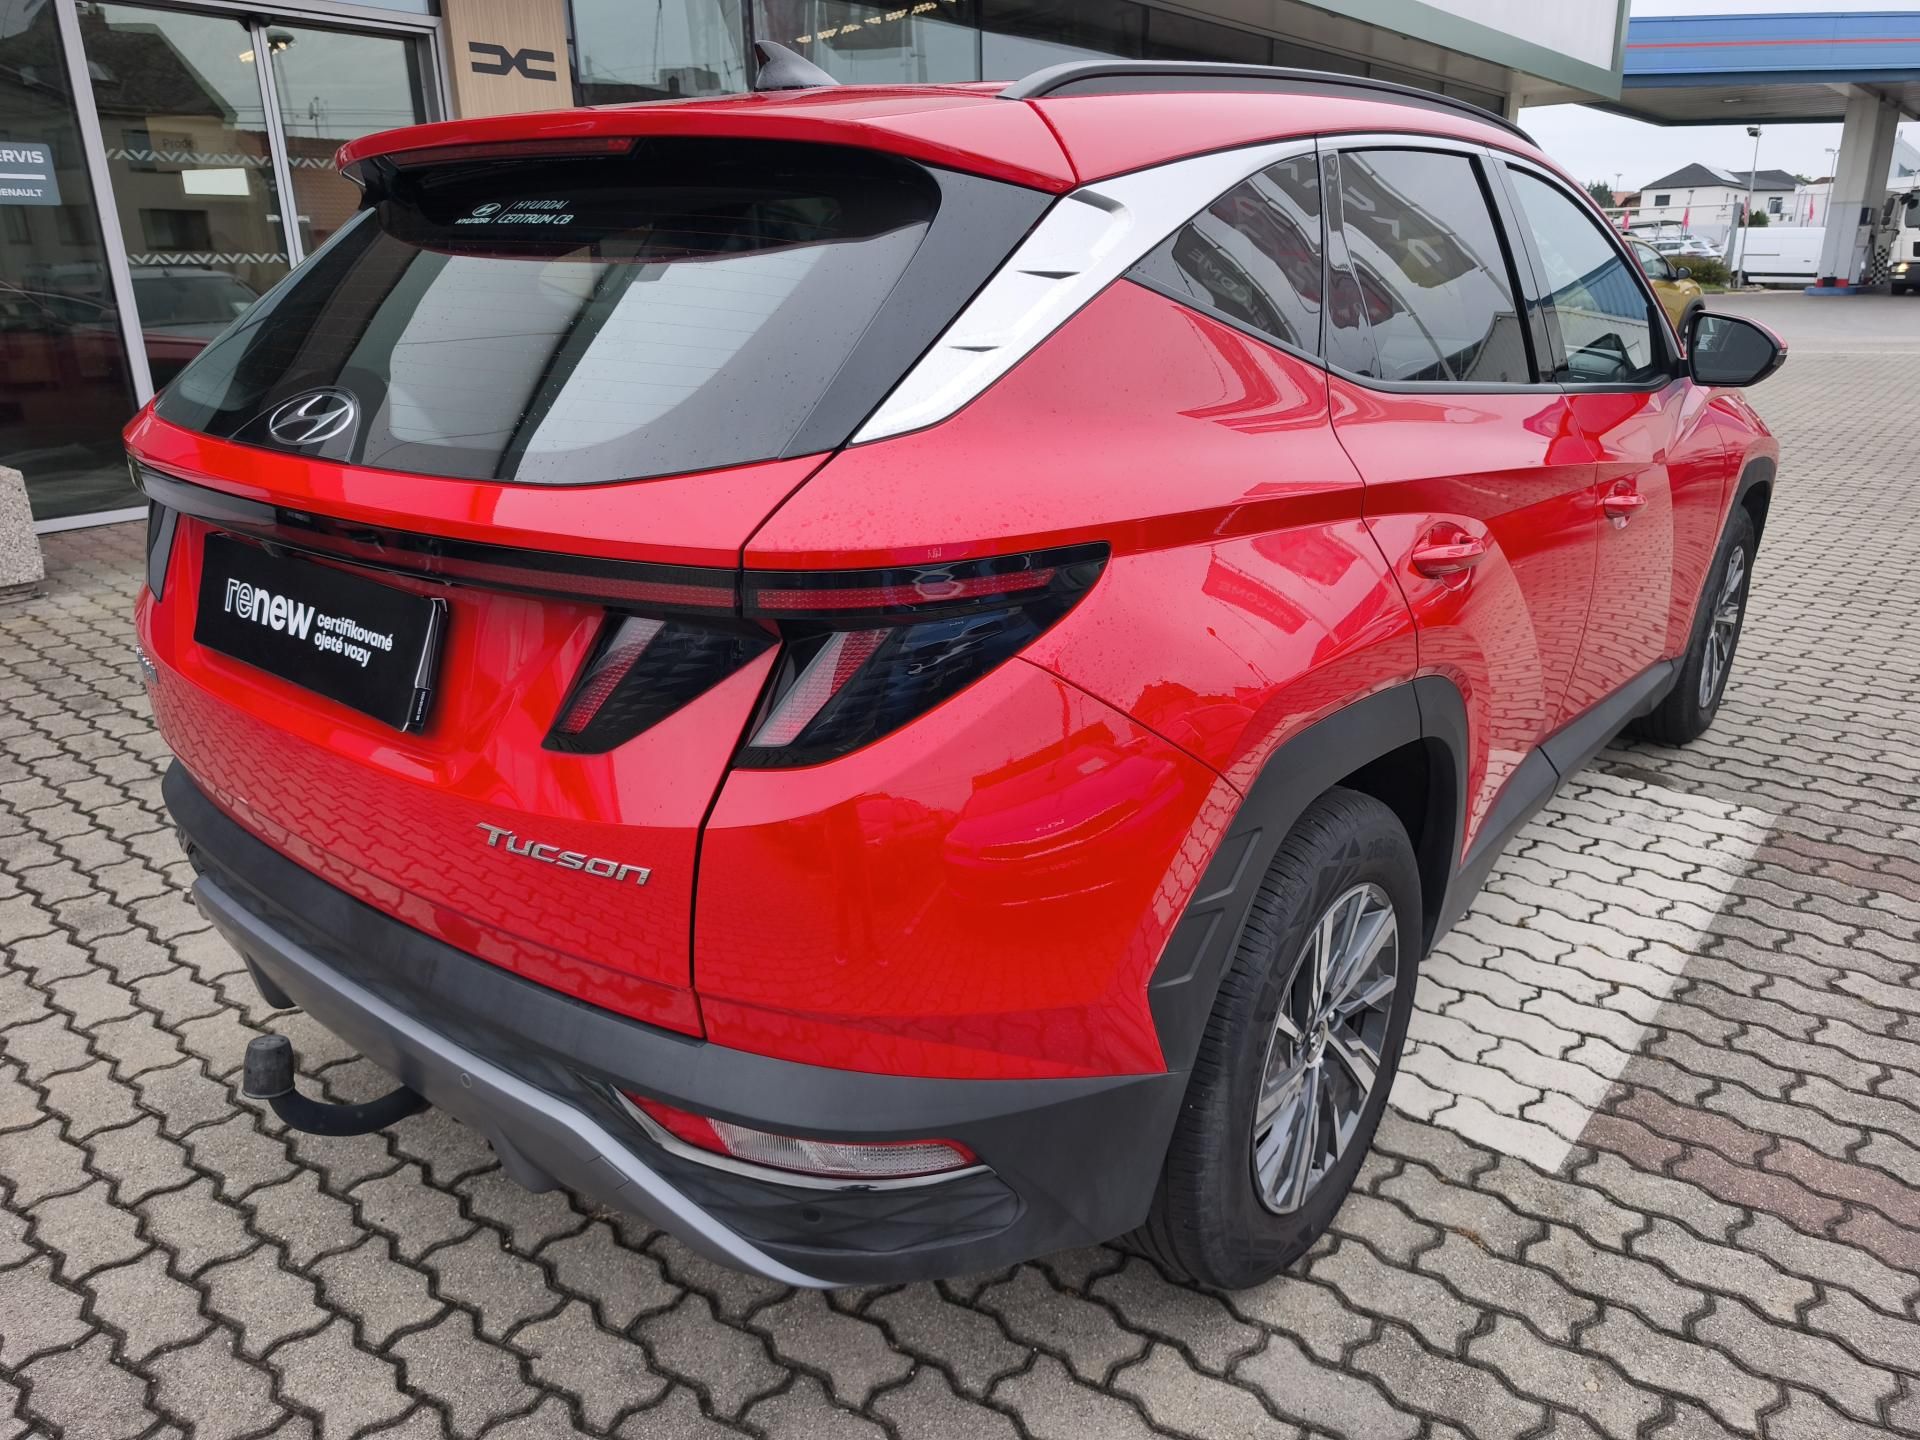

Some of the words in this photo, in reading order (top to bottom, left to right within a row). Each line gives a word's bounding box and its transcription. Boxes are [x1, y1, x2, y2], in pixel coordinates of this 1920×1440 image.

[498, 213, 557, 224] CENTRUM
[553, 214, 575, 225] CB
[513, 200, 570, 209] HYUNDAI
[224, 577, 316, 640] renew
[314, 630, 344, 654] ojeté
[344, 641, 372, 668] vozy
[317, 613, 394, 652] certifikované
